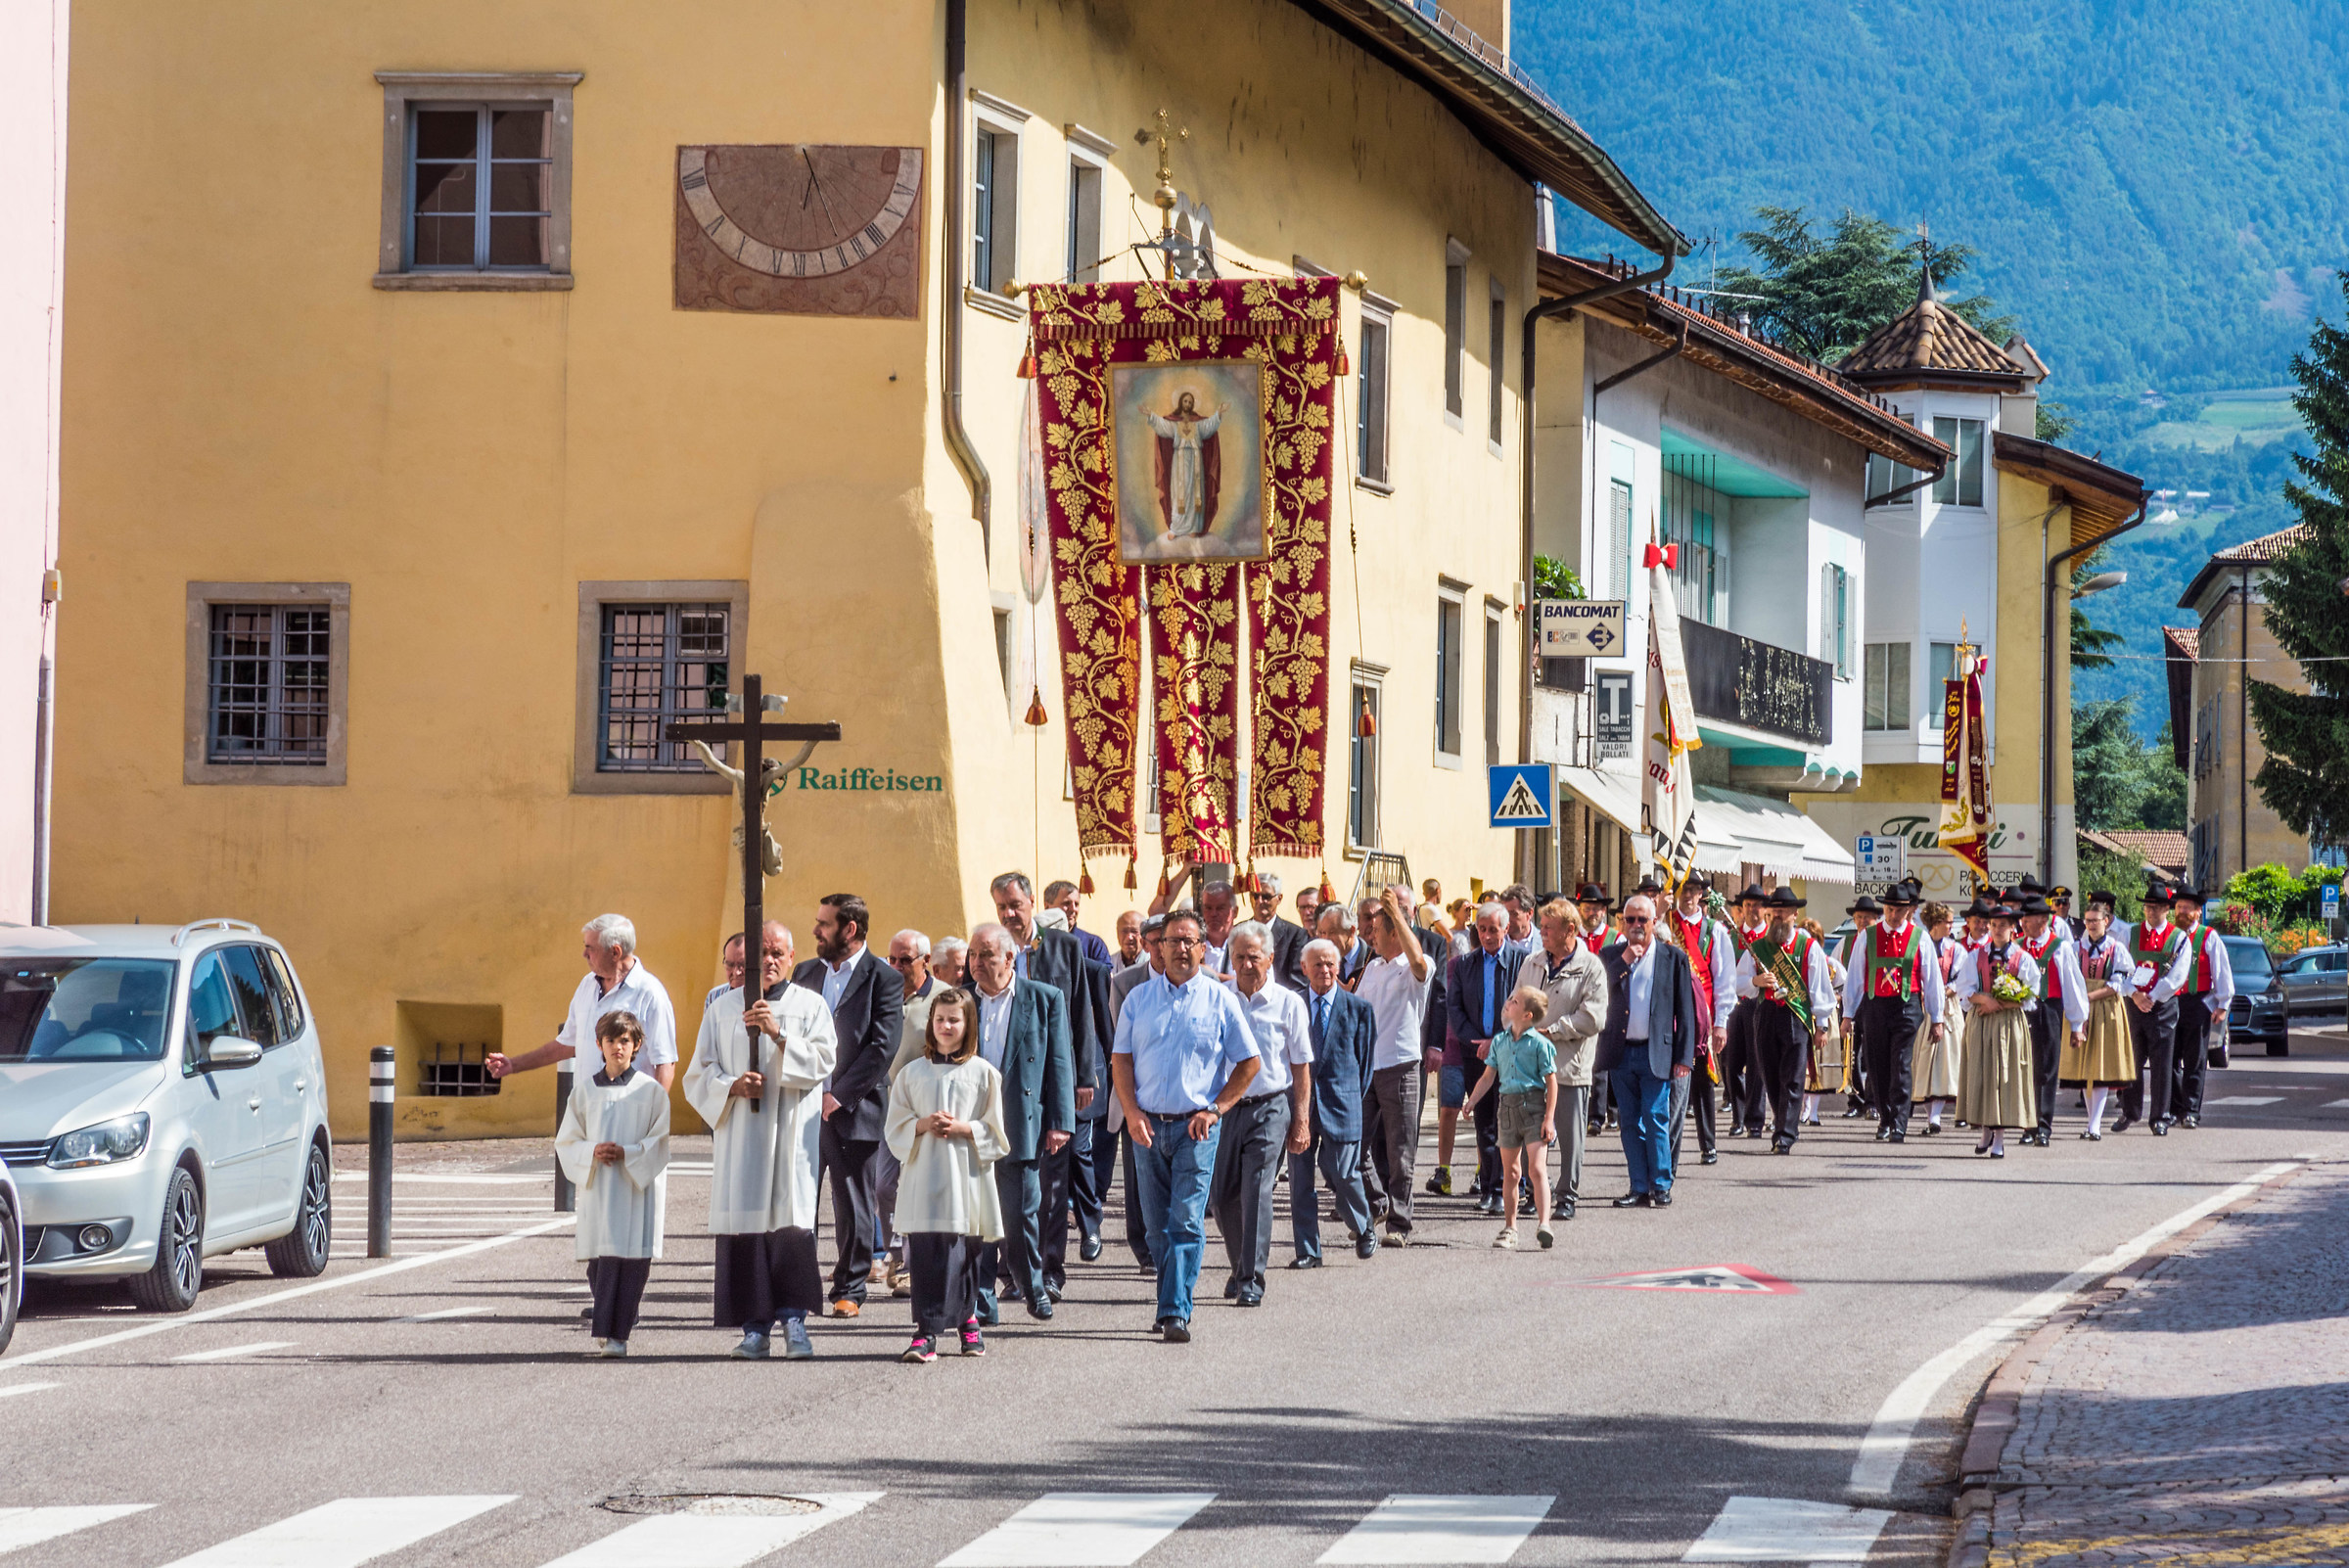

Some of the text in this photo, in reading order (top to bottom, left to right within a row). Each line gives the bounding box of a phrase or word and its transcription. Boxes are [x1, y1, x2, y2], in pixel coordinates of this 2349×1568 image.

[1543, 605, 1621, 619] BANCOMAT
[1601, 678, 1629, 724] T
[798, 766, 943, 792] Raiffeisen
[1861, 839, 1870, 851] P
[2326, 887, 2335, 900] P
